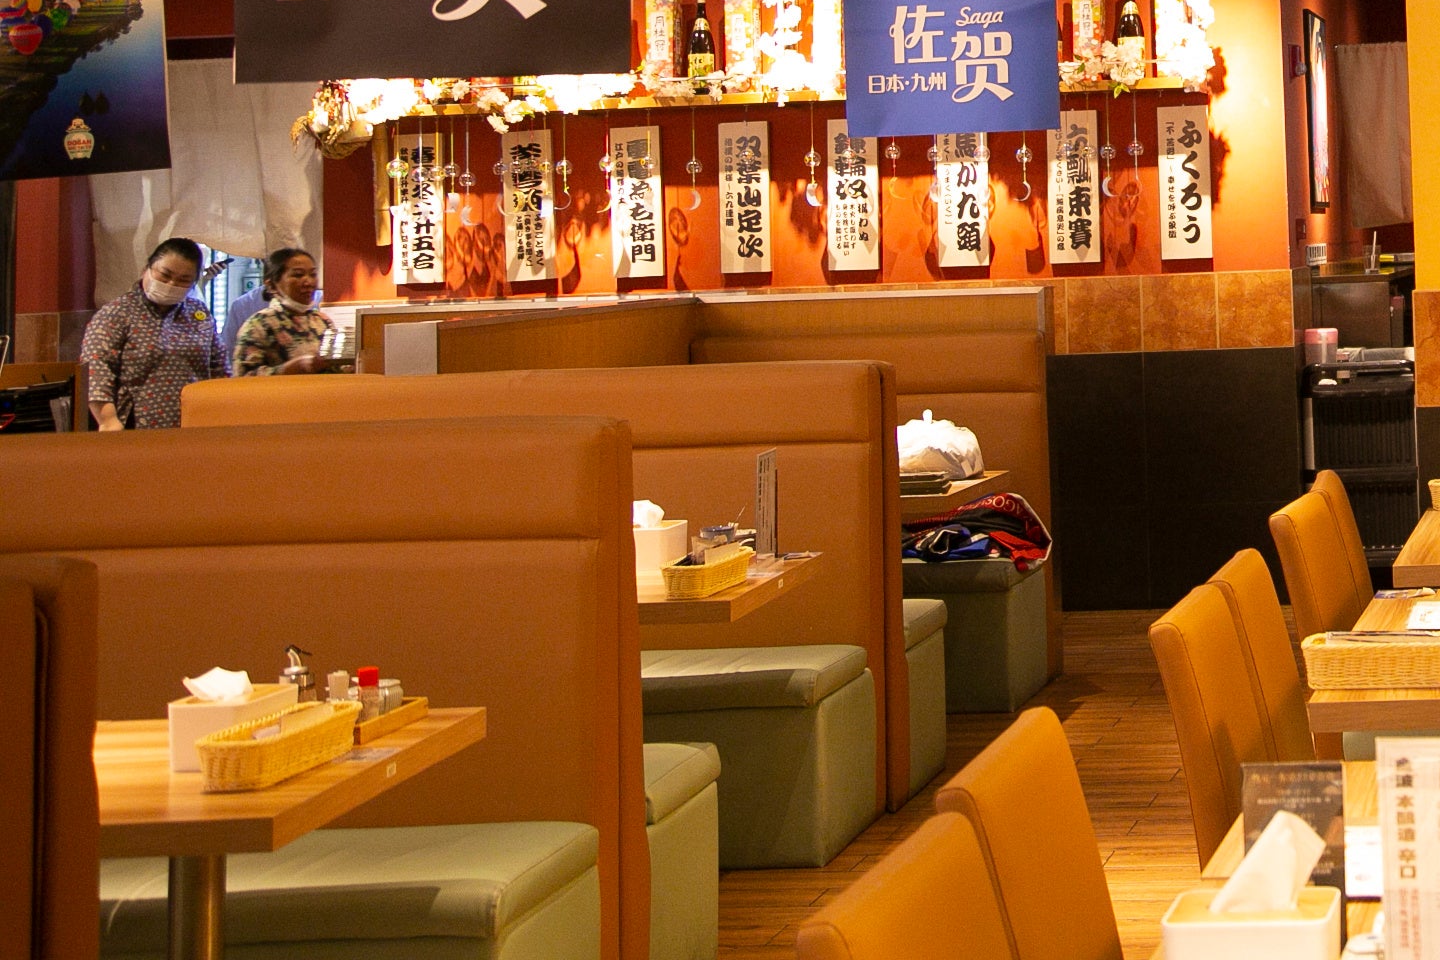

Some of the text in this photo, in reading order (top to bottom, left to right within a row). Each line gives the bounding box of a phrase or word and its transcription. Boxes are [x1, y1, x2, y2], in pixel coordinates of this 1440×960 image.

[889, 4, 1015, 103] 佐贺
[955, 6, 1004, 29] Saga
[1176, 119, 1203, 244] ふくろう
